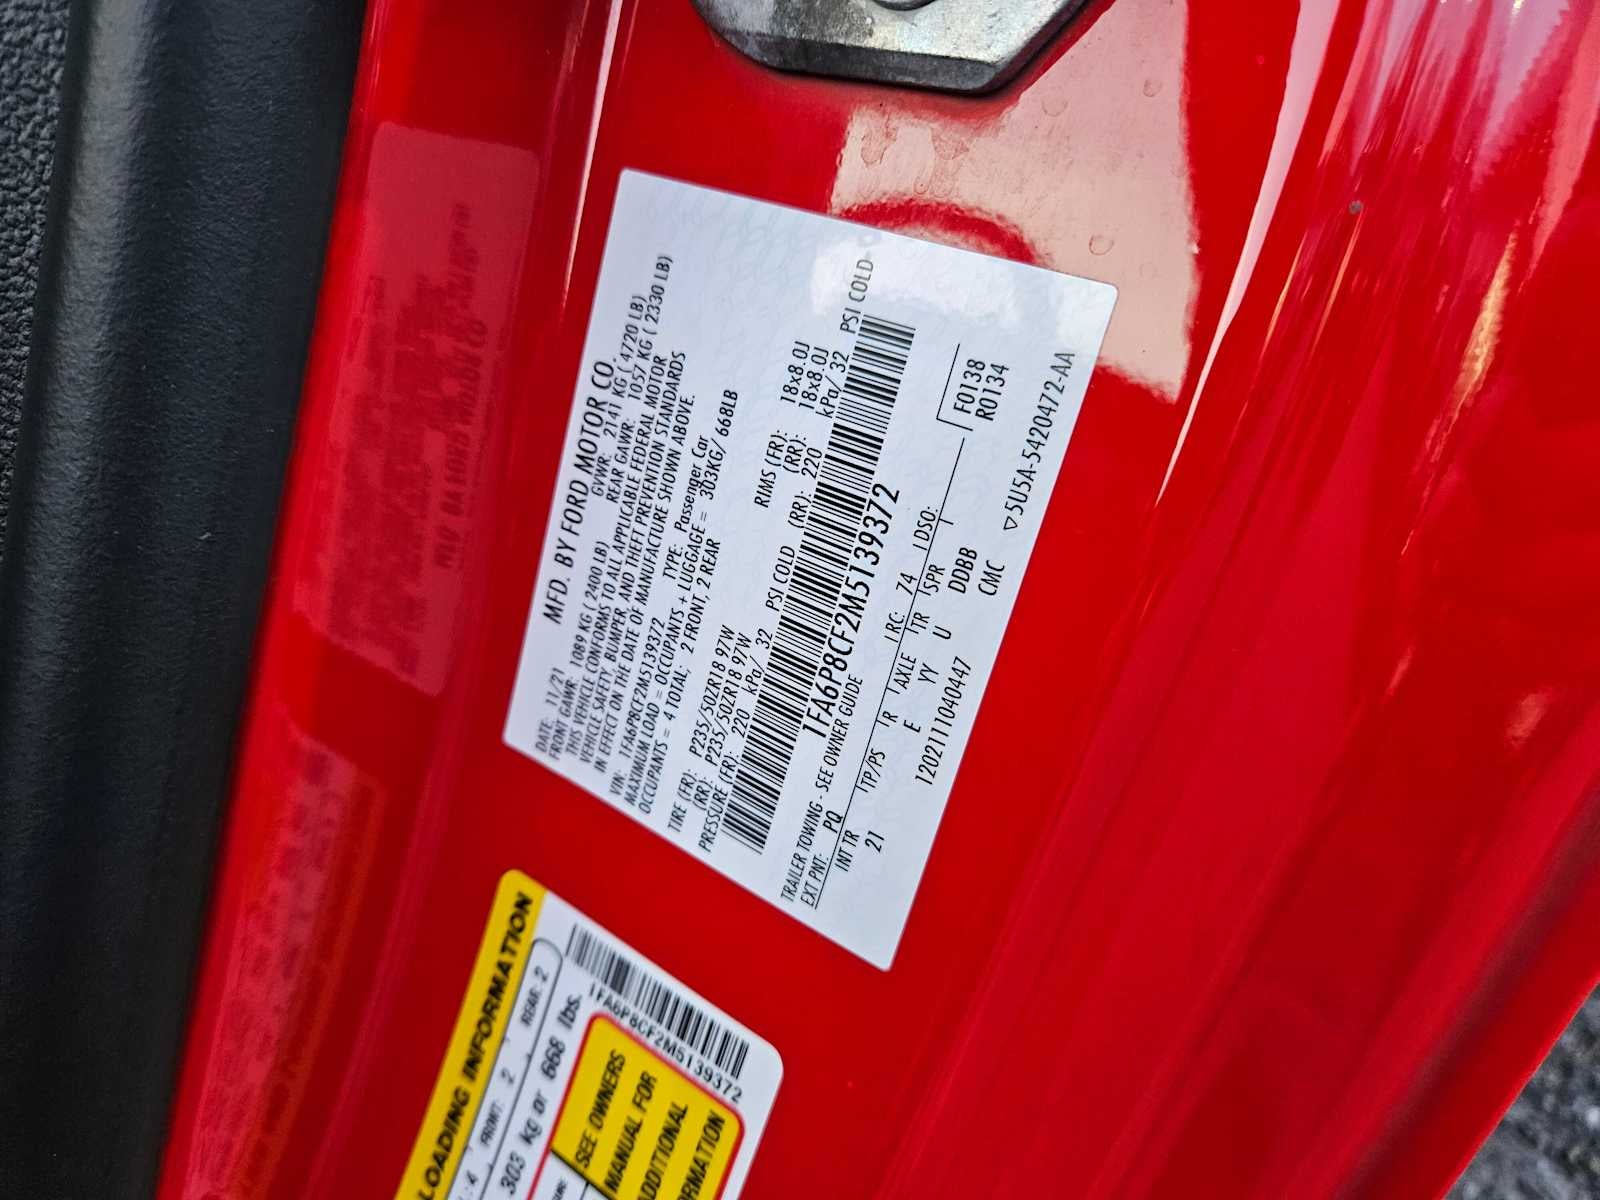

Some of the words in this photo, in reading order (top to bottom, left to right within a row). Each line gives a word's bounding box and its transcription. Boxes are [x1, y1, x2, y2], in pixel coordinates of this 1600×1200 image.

[653, 255, 673, 281] LB)
[847, 258, 874, 303] COLD
[627, 295, 647, 321] LB)
[839, 306, 861, 334] PSI
[636, 338, 653, 361] KG
[828, 350, 850, 373] 32
[590, 357, 618, 394] CO.
[610, 376, 628, 398] KG
[626, 363, 647, 400] 1057
[643, 354, 668, 409] MOTOR
[779, 340, 810, 404] 18x8.0J
[952, 358, 986, 414] F0138
[654, 351, 686, 437] STANDARDS
[781, 433, 806, 474] (RR):
[797, 346, 829, 410] 18x8.0J
[814, 374, 841, 419] kPa/
[974, 363, 1009, 421] R0134
[572, 395, 610, 476] MOTOR
[602, 402, 622, 439] 2141
[670, 395, 695, 447] ABOVE.
[613, 418, 636, 465] GAWR:
[629, 413, 655, 473] FEDERAL
[763, 429, 788, 467] (FR):
[590, 452, 612, 497] GVWR:
[656, 447, 682, 503] SHOWN
[798, 444, 823, 480] 220
[605, 467, 625, 504] REAR
[633, 439, 666, 527] PREVENTION
[753, 468, 777, 508] RIMS
[560, 479, 592, 536] FORD
[611, 473, 641, 555] APPLICABLE
[787, 490, 812, 529] (RR):
[553, 536, 576, 568] BY
[592, 540, 610, 564] LB)
[624, 527, 645, 568] THEFT
[633, 503, 669, 606] MANUFACTURE
[698, 537, 721, 576] REAR
[772, 545, 795, 584] COLD
[605, 557, 623, 582] ALL
[617, 571, 635, 603] AND
[695, 576, 711, 590] 2
[922, 563, 946, 593] SPR
[947, 546, 978, 594] DDBB
[977, 559, 1005, 596] CMC
[542, 577, 570, 625] MFD.
[600, 582, 616, 601] TO
[623, 738, 651, 806] MAXIMUM
[640, 701, 660, 739] LOAD
[653, 607, 685, 685] OCCUPANTS
[676, 522, 706, 592] LUGGAGE
[698, 437, 726, 500] 303KG/
[714, 389, 738, 437] 668LB
[764, 586, 785, 612] PSI
[801, 482, 900, 738] 1FA6P8CF2M5139372
[884, 611, 905, 634] RC:
[895, 571, 918, 596] 74
[577, 612, 592, 633] KG
[608, 770, 627, 796] VIN:
[618, 616, 666, 758] 1FA6P8CF2M5139372
[661, 543, 683, 580] TYPE:
[673, 462, 703, 533] Passenger
[690, 434, 709, 459] Car
[628, 605, 644, 625] OF
[682, 592, 710, 641] FRONT,
[909, 611, 930, 630] TR
[931, 624, 952, 640] U
[569, 633, 587, 668] 1089
[584, 602, 612, 674] CONFORMS
[603, 607, 630, 663] BUMPER,
[620, 626, 640, 662] DATE
[679, 641, 695, 654] 2
[714, 623, 735, 659] 97W
[754, 627, 773, 650] 32
[544, 666, 565, 707] 11/21
[591, 666, 616, 714] SAFETY,
[613, 662, 631, 688] THE
[664, 664, 691, 709] TOTAL;
[740, 654, 764, 696] kPa/
[892, 651, 917, 690] AXLE
[916, 661, 939, 684] YY
[557, 676, 579, 718] GAWR:
[572, 675, 596, 725] VEHICLE
[608, 689, 624, 711] ON
[688, 660, 726, 758] P235/50ZR18
[837, 673, 863, 717] GUIDE
[597, 711, 619, 756] EFFECT
[662, 710, 676, 721] 4
[691, 776, 713, 811] (RR):
[704, 668, 743, 767] P235/50ZR18
[730, 631, 752, 667] 97W
[730, 707, 751, 739] 220
[881, 710, 898, 723] R
[902, 719, 921, 733] E
[914, 655, 971, 785] 1202111040447
[534, 719, 555, 753] DATE:
[548, 718, 568, 760] FRONT
[564, 726, 583, 756] THIS
[578, 712, 603, 764] VEHICLE
[822, 717, 850, 767] OWNER
[593, 756, 608, 773] IN
[638, 738, 668, 814] OCCUPANTS
[717, 750, 739, 785] (FR):
[814, 765, 834, 793] SEE
[859, 747, 886, 788] TP/PS
[676, 768, 697, 802] (FR):
[666, 801, 687, 833] TIRE
[698, 784, 729, 853] PRESSURE
[795, 800, 823, 852] TOWING
[821, 809, 843, 834] PQ
[840, 828, 860, 847] TR
[864, 829, 885, 853] 21
[780, 852, 807, 902] TRAILER
[807, 852, 829, 882] PNT:
[833, 845, 853, 872] INT
[799, 879, 819, 907] EXT
[534, 964, 549, 982] 2
[557, 993, 583, 1031] lbs.
[416, 1085, 471, 1200] LOADING
[462, 891, 533, 1082] INFORMATION
[540, 1036, 566, 1081] 668
[589, 983, 743, 1104] 1FA6P8CF2M5139372
[501, 1067, 516, 1085] 2
[532, 1088, 549, 1115] or
[575, 1129, 599, 1169] SEE
[588, 1049, 626, 1130] OWNERS
[519, 1117, 543, 1145] kg
[604, 1115, 643, 1194] MANUAL
[632, 1070, 658, 1114] FOR
[637, 1101, 689, 1200] DDITIONAL
[500, 1151, 527, 1196] 303
